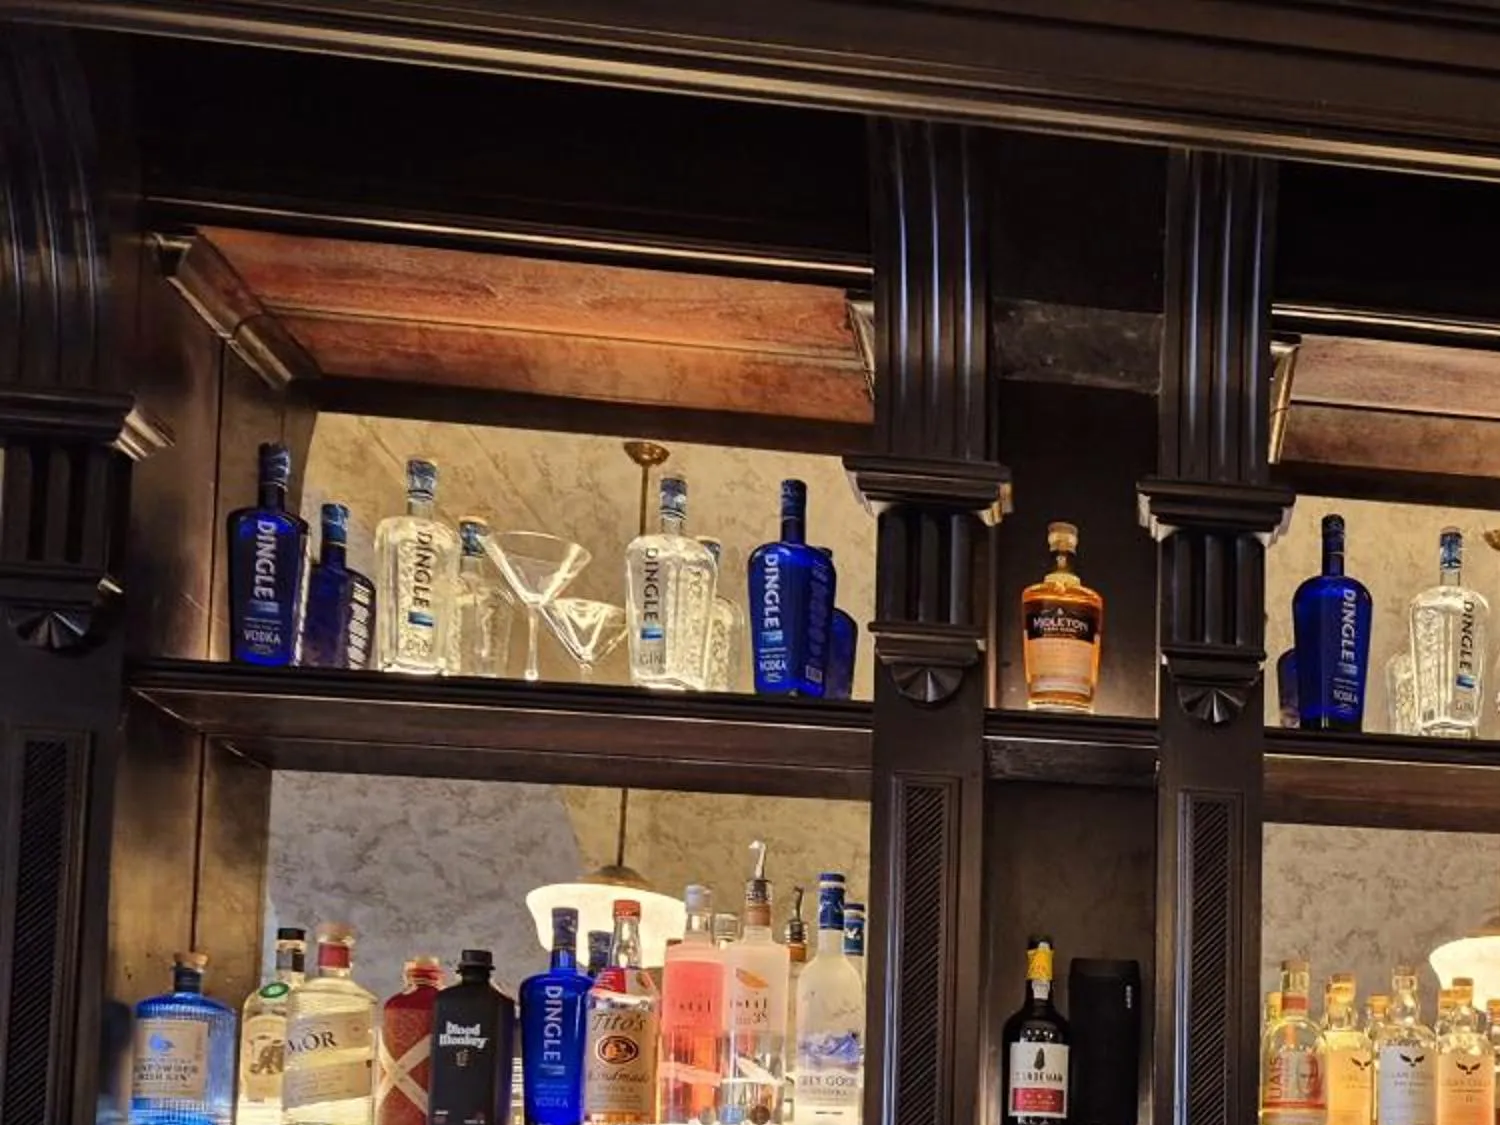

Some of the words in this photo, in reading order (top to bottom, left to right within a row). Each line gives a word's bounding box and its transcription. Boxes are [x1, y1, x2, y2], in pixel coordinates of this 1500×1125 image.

[254, 520, 277, 598] DINGLE
[413, 530, 433, 609] DINGLE
[643, 547, 660, 622] DINGLE
[763, 553, 780, 629] DINGLE
[1340, 588, 1358, 661] DINGLE
[1458, 601, 1475, 671] DINGLE
[542, 986, 564, 1061] DINGLE
[591, 1011, 647, 1033] Tito's
